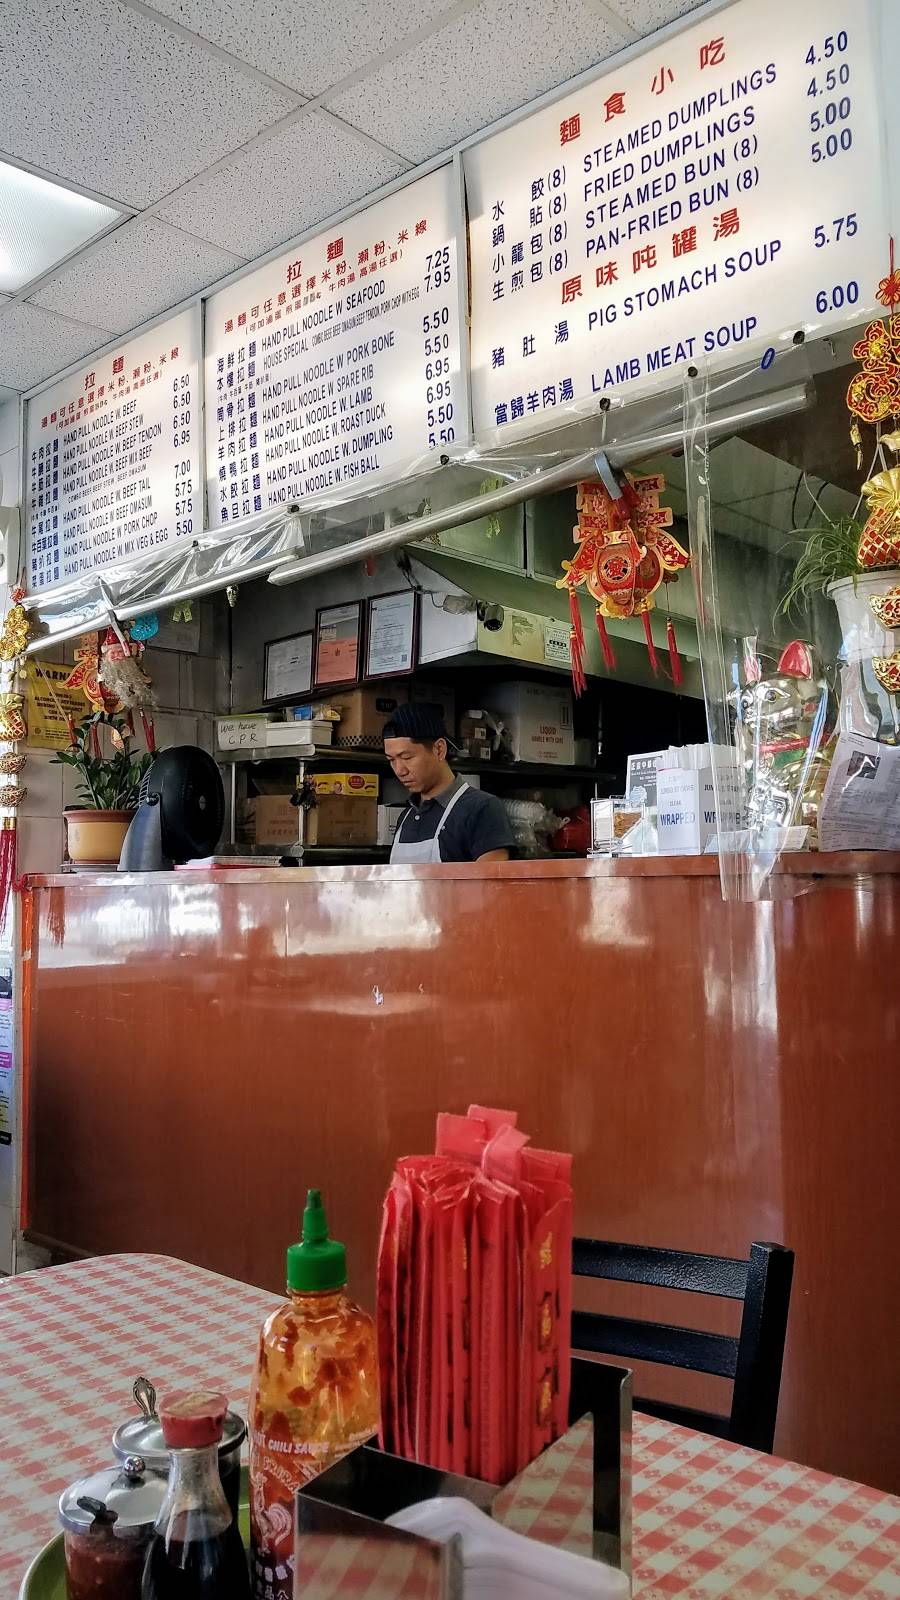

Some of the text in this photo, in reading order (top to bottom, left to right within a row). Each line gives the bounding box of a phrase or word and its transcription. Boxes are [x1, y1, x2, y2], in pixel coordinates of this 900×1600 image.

[805, 28, 848, 68] 4.50
[559, 35, 726, 147] 麵食小吃
[806, 61, 850, 100] 4.50
[583, 61, 777, 173] STEAMED DUMPLINGS
[810, 94, 851, 133] 5.00
[583, 103, 755, 201] FRIED DUMPLINGS
[811, 126, 853, 164] 5.00
[585, 133, 758, 229] STEAMED BUN (8)
[585, 165, 759, 258] PAN-FRIED BUN (8)
[813, 211, 858, 249] 5.75
[286, 236, 343, 283] 拉麵
[425, 247, 449, 273] 7.25
[425, 266, 450, 293] 7.95
[588, 238, 781, 330] PIG STOMACH SOUP
[815, 278, 859, 315] 6.00
[261, 329, 280, 351] HAND
[283, 320, 299, 341] PULL
[302, 304, 332, 332] NOODLE
[346, 278, 385, 311] SEAFOOD
[422, 307, 448, 334] 5.50
[263, 336, 307, 370] HOUSE SPECIAL
[424, 332, 449, 358] 5.50
[491, 319, 568, 369] 豬肚湯
[591, 315, 757, 392] LAMB MEAT SOUP
[172, 373, 189, 392] 6.50
[262, 380, 281, 402] HAND
[283, 372, 300, 393] PULL
[303, 357, 333, 385] NOODLE
[346, 341, 369, 366] PORK
[372, 330, 394, 355] BONE
[425, 357, 449, 381] 6.95
[173, 390, 189, 411] 6.50
[262, 363, 373, 424] HAND PULL NOODLE SPARE RIB
[426, 380, 450, 404] 6.95
[494, 377, 573, 426] 當歸羊肉湯
[63, 428, 77, 446] HAND
[78, 422, 90, 439] PULL
[92, 410, 113, 432] NOODLE
[122, 399, 136, 417] BEEF
[173, 411, 190, 430] 6.50
[264, 421, 284, 443] HAND
[286, 413, 303, 434] PULL
[305, 400, 336, 426] NOODLE
[349, 385, 372, 409] LAMB
[265, 442, 282, 463] HAND
[284, 435, 300, 455] PULL
[302, 424, 328, 448] NOODLE
[341, 410, 363, 434] ROAST
[366, 402, 384, 424] DUCK
[427, 403, 452, 428] 5.50
[62, 461, 76, 479] HAND
[78, 455, 90, 472] PULL
[91, 444, 113, 466] NOODLE
[122, 433, 136, 452] BEEF
[138, 422, 161, 445] TENDON
[63, 412, 143, 462] HAND PULL NOODLE BEEF STEW
[174, 429, 190, 448] 6.95
[267, 464, 286, 485] HAND
[288, 457, 305, 477] PULL
[308, 444, 339, 470] NOODLE
[352, 424, 392, 454] DUMPLING
[428, 427, 454, 448] 5.50
[63, 478, 75, 495] HAND
[76, 472, 87, 489] PULL
[89, 463, 107, 483] NOODLE
[115, 454, 127, 472] BEEF
[128, 450, 137, 466] MIX
[139, 443, 152, 461] BEEF
[174, 460, 191, 479] 7.00
[175, 479, 191, 498] 5.75
[268, 486, 286, 506] HAND
[288, 480, 303, 499] PULL
[306, 469, 332, 493] NOODLE
[343, 460, 359, 480] FISH
[360, 453, 379, 474] BALL
[63, 507, 76, 524] HAND
[78, 501, 90, 518] PULL
[92, 491, 113, 512] NOODLE
[122, 482, 136, 500] BEEF
[138, 476, 150, 493] TAIL
[175, 498, 192, 517] 5.75
[63, 524, 76, 541] HAND
[77, 520, 87, 536] PULL
[89, 512, 108, 531] NOODLE
[116, 504, 128, 521] BEEF
[64, 511, 157, 558] HAND PULL NOODLE PORK CHOP
[175, 519, 192, 538] 5.50
[65, 527, 167, 576] HAND PULL NOODLE MIX VEG & EGG
[660, 812, 696, 826] WRAPPED
[268, 1439, 292, 1454] CHILI
[294, 1442, 329, 1455] SAUCE
